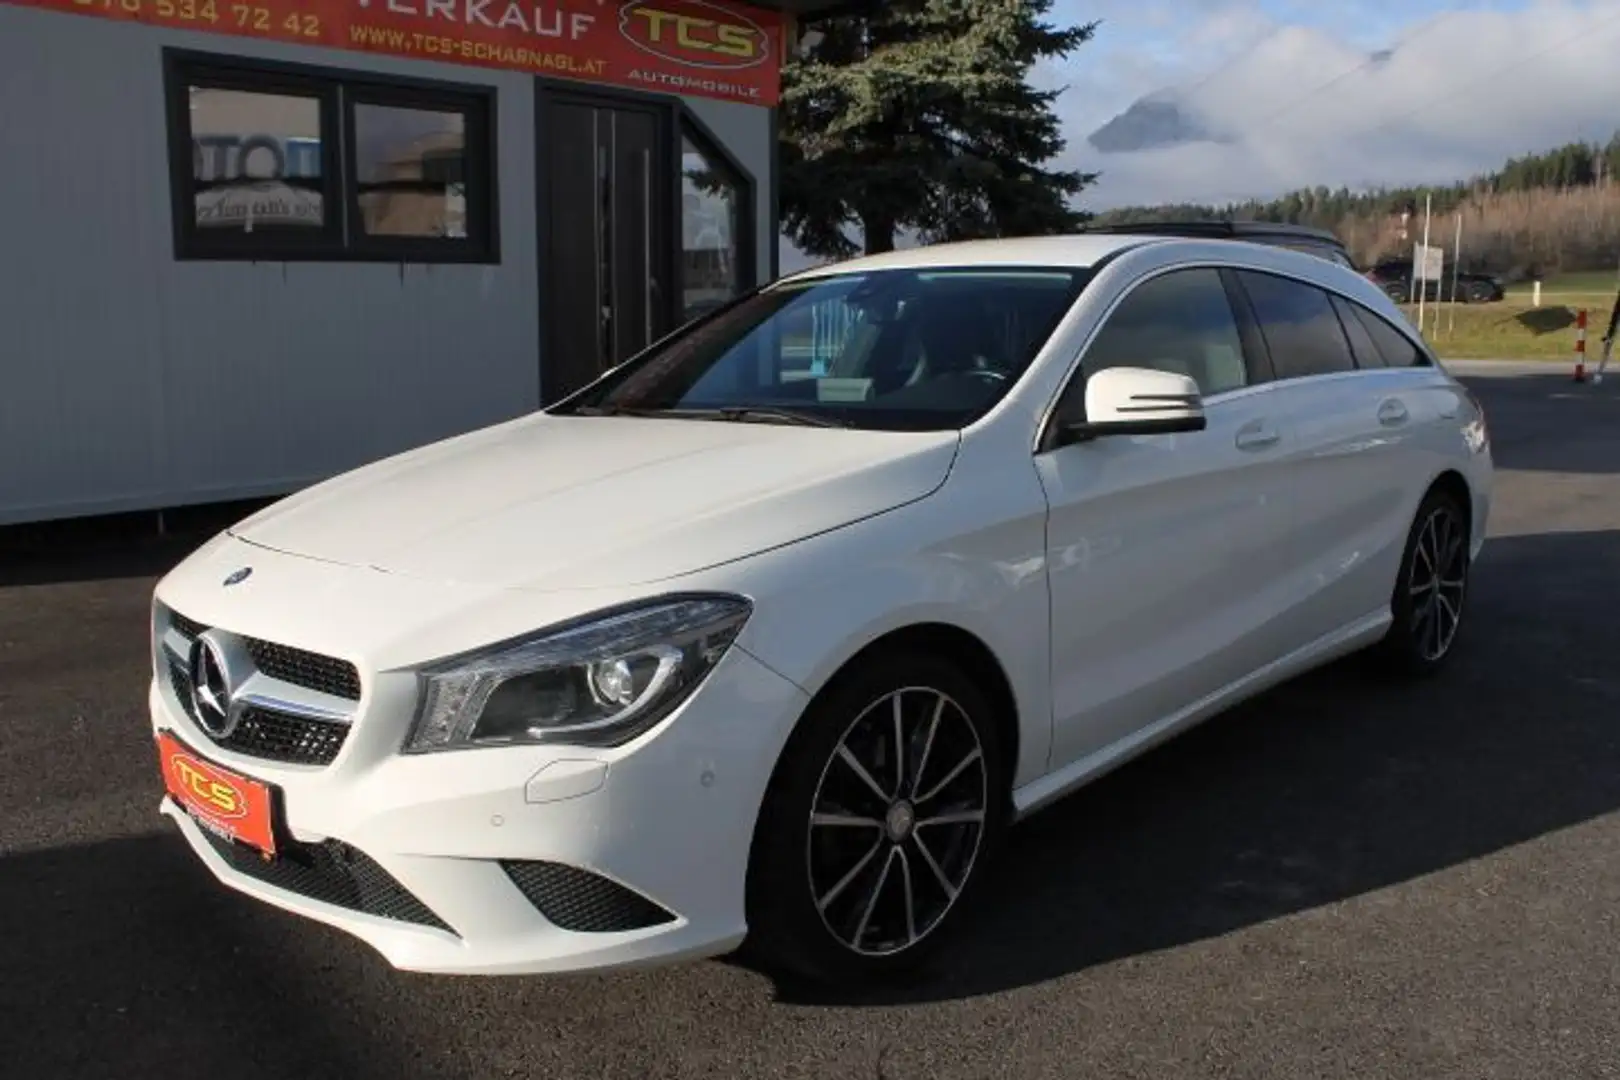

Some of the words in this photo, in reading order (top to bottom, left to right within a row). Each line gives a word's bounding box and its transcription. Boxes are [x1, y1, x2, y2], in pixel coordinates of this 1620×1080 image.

[157, 0, 219, 24] 534
[230, 6, 271, 31] 72
[283, 14, 320, 37] 42
[357, 0, 597, 41] RKAUF
[631, 8, 756, 57] TCS
[627, 67, 762, 98] AUTOMOBILE
[175, 760, 236, 812] TCS
